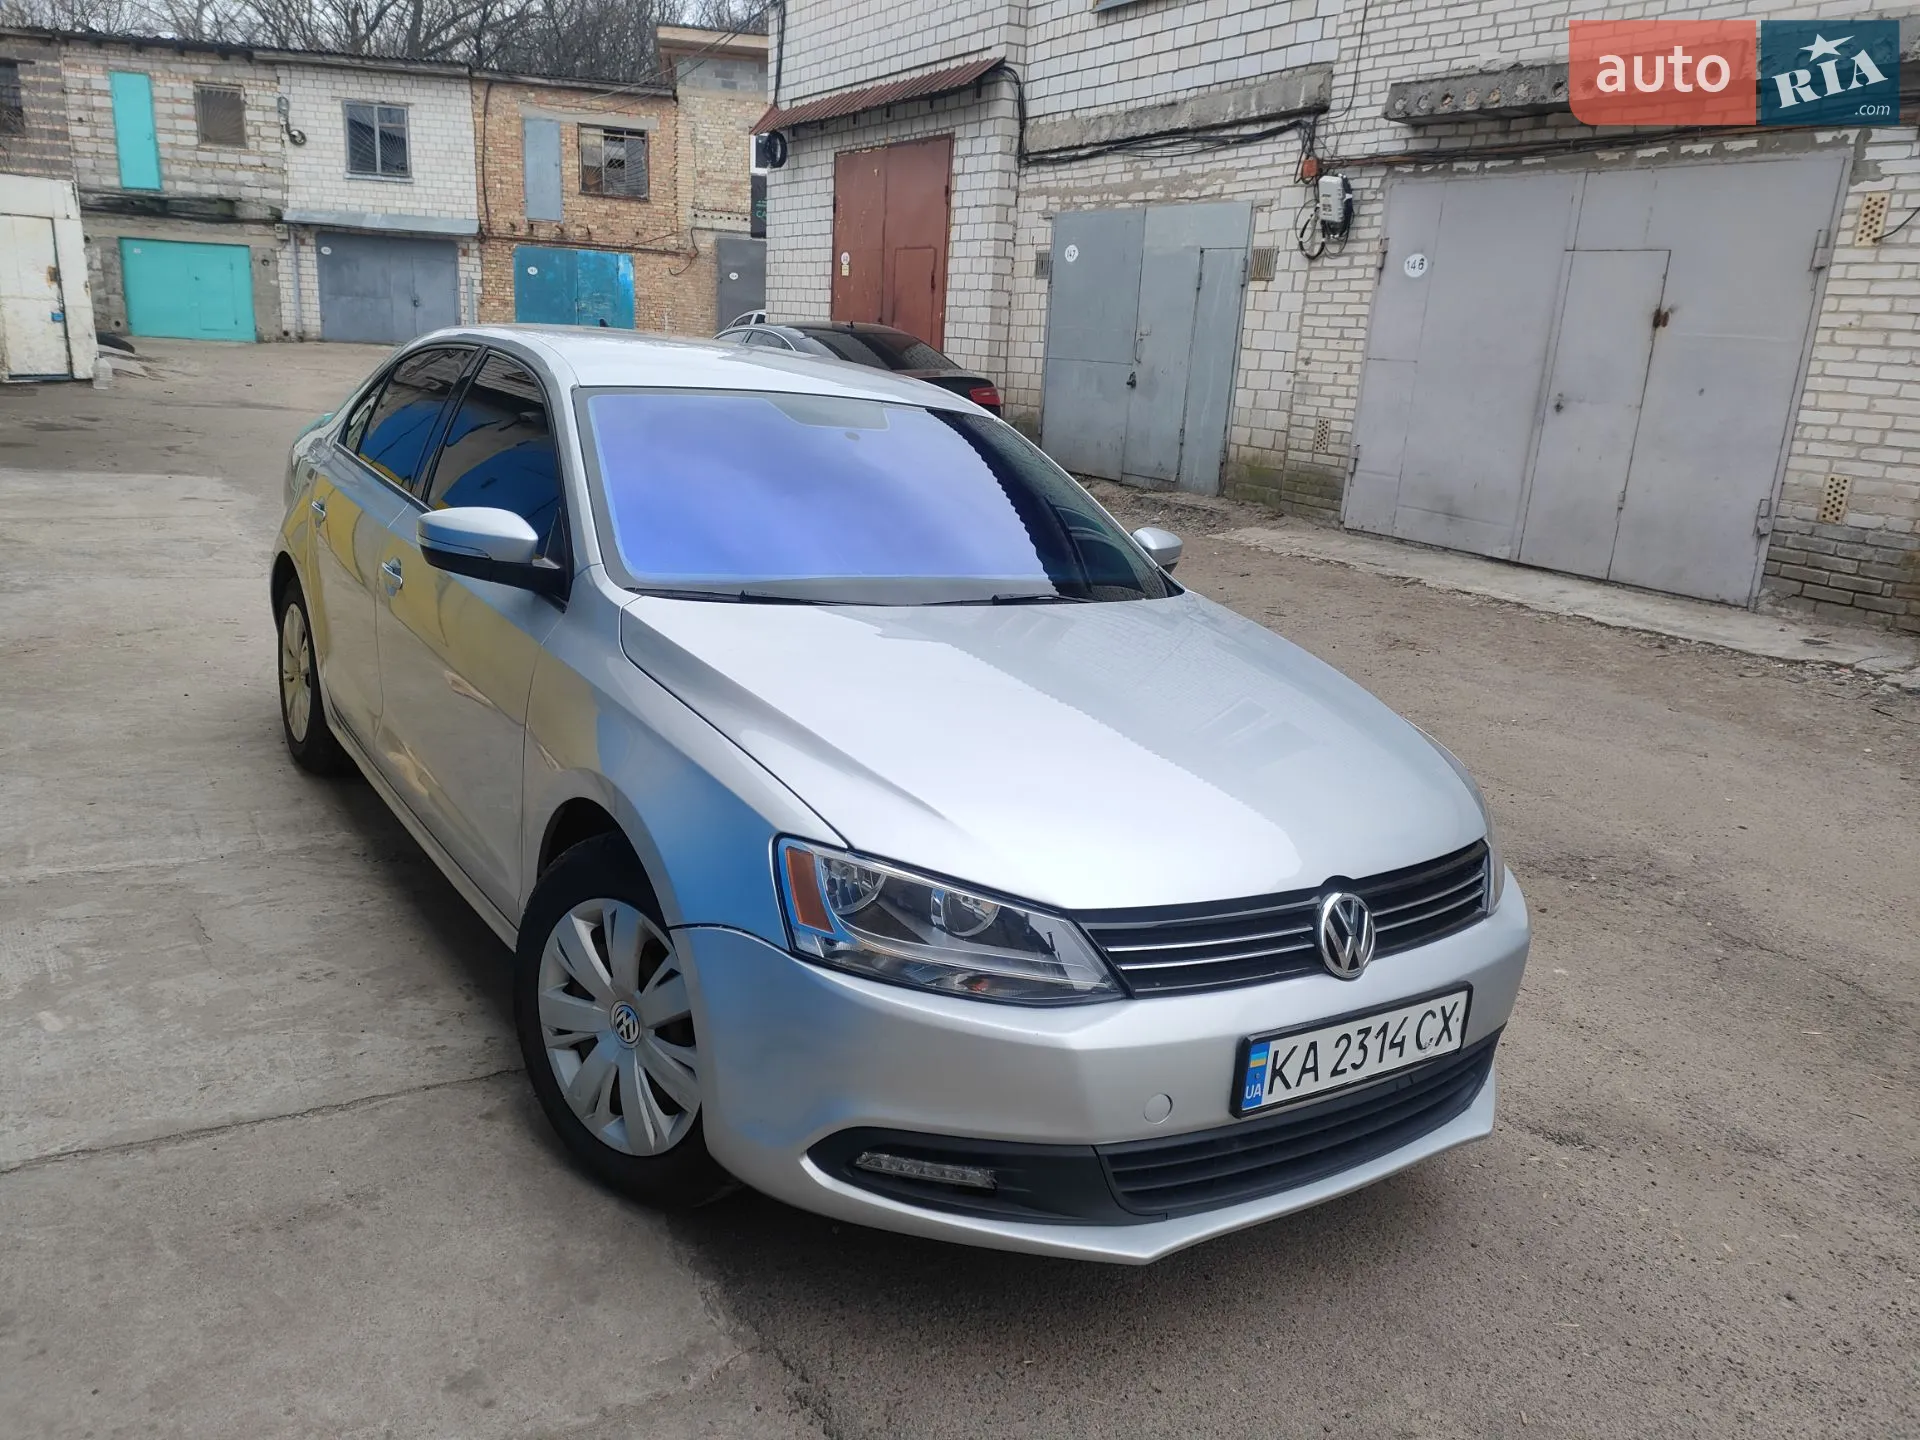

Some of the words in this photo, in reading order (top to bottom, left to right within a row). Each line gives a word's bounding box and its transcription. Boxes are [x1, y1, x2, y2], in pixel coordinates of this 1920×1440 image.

[1268, 1041, 1319, 1095] KA
[1330, 1017, 1408, 1077] 2314
[1415, 1002, 1458, 1050] CX
[1245, 1084, 1262, 1099] UA
